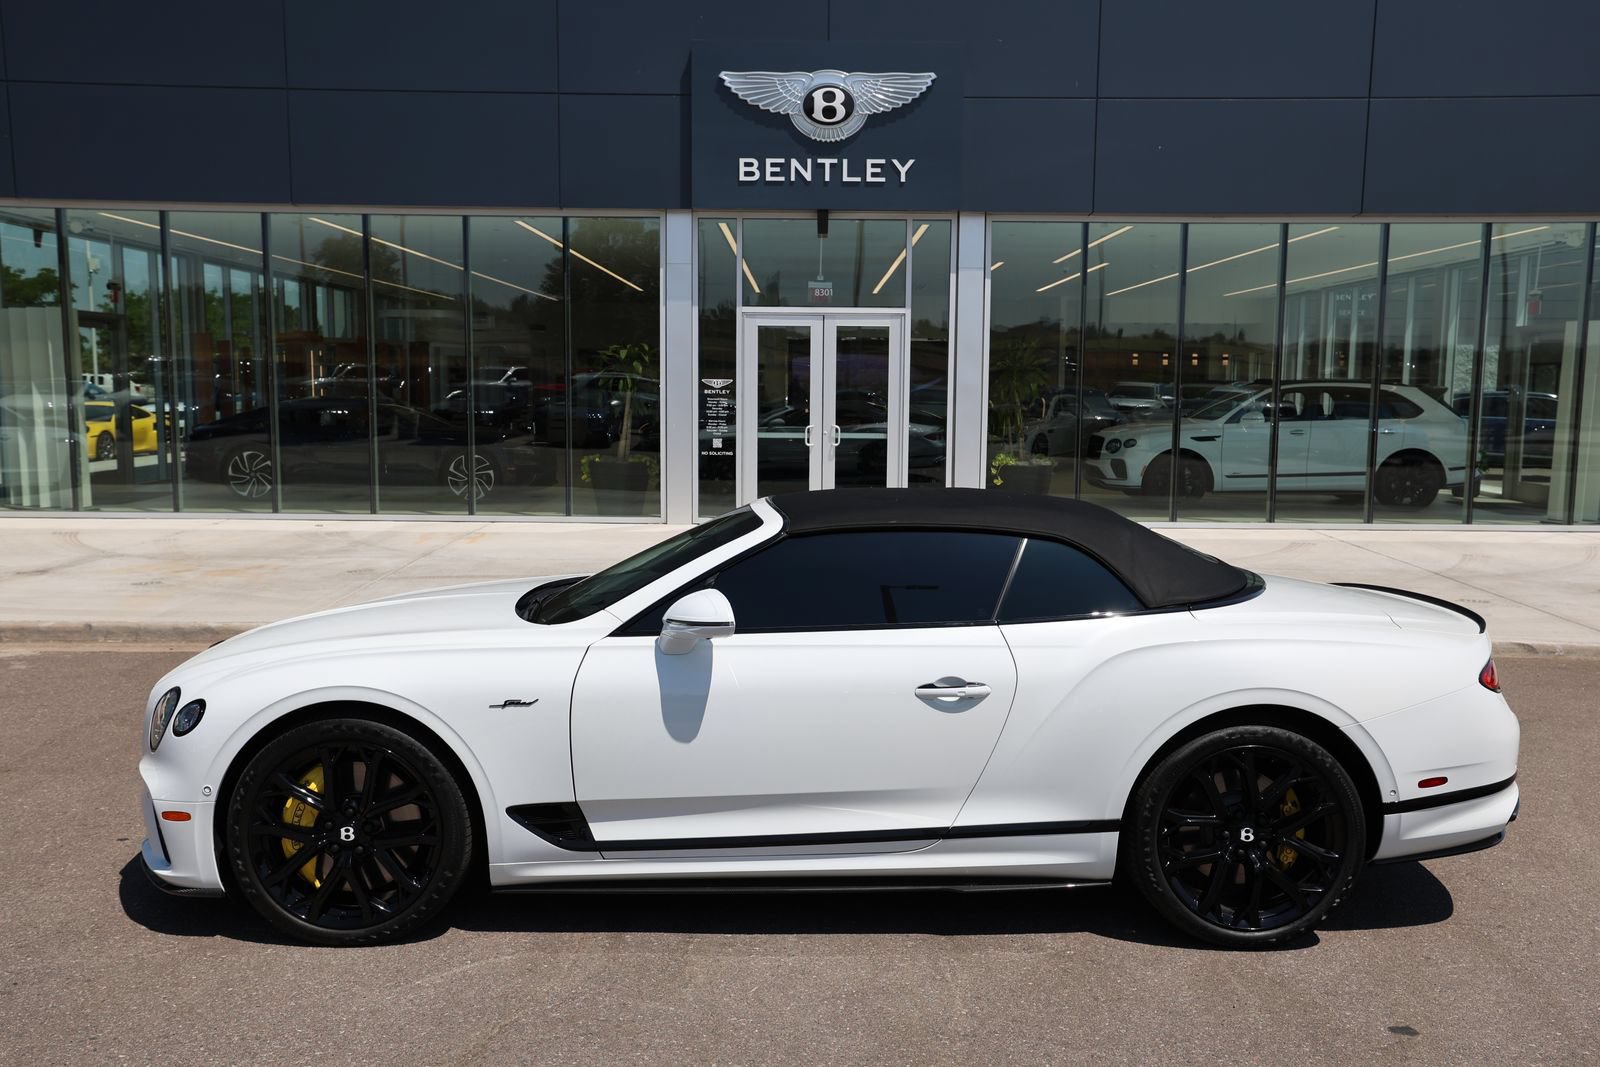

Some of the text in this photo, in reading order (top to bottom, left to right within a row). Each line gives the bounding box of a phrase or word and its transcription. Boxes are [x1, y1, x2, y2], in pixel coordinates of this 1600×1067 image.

[811, 87, 847, 123] B
[738, 157, 916, 183] BENTLEY
[814, 288, 833, 297] 8301
[340, 826, 355, 842] B
[1240, 827, 1255, 842] B
